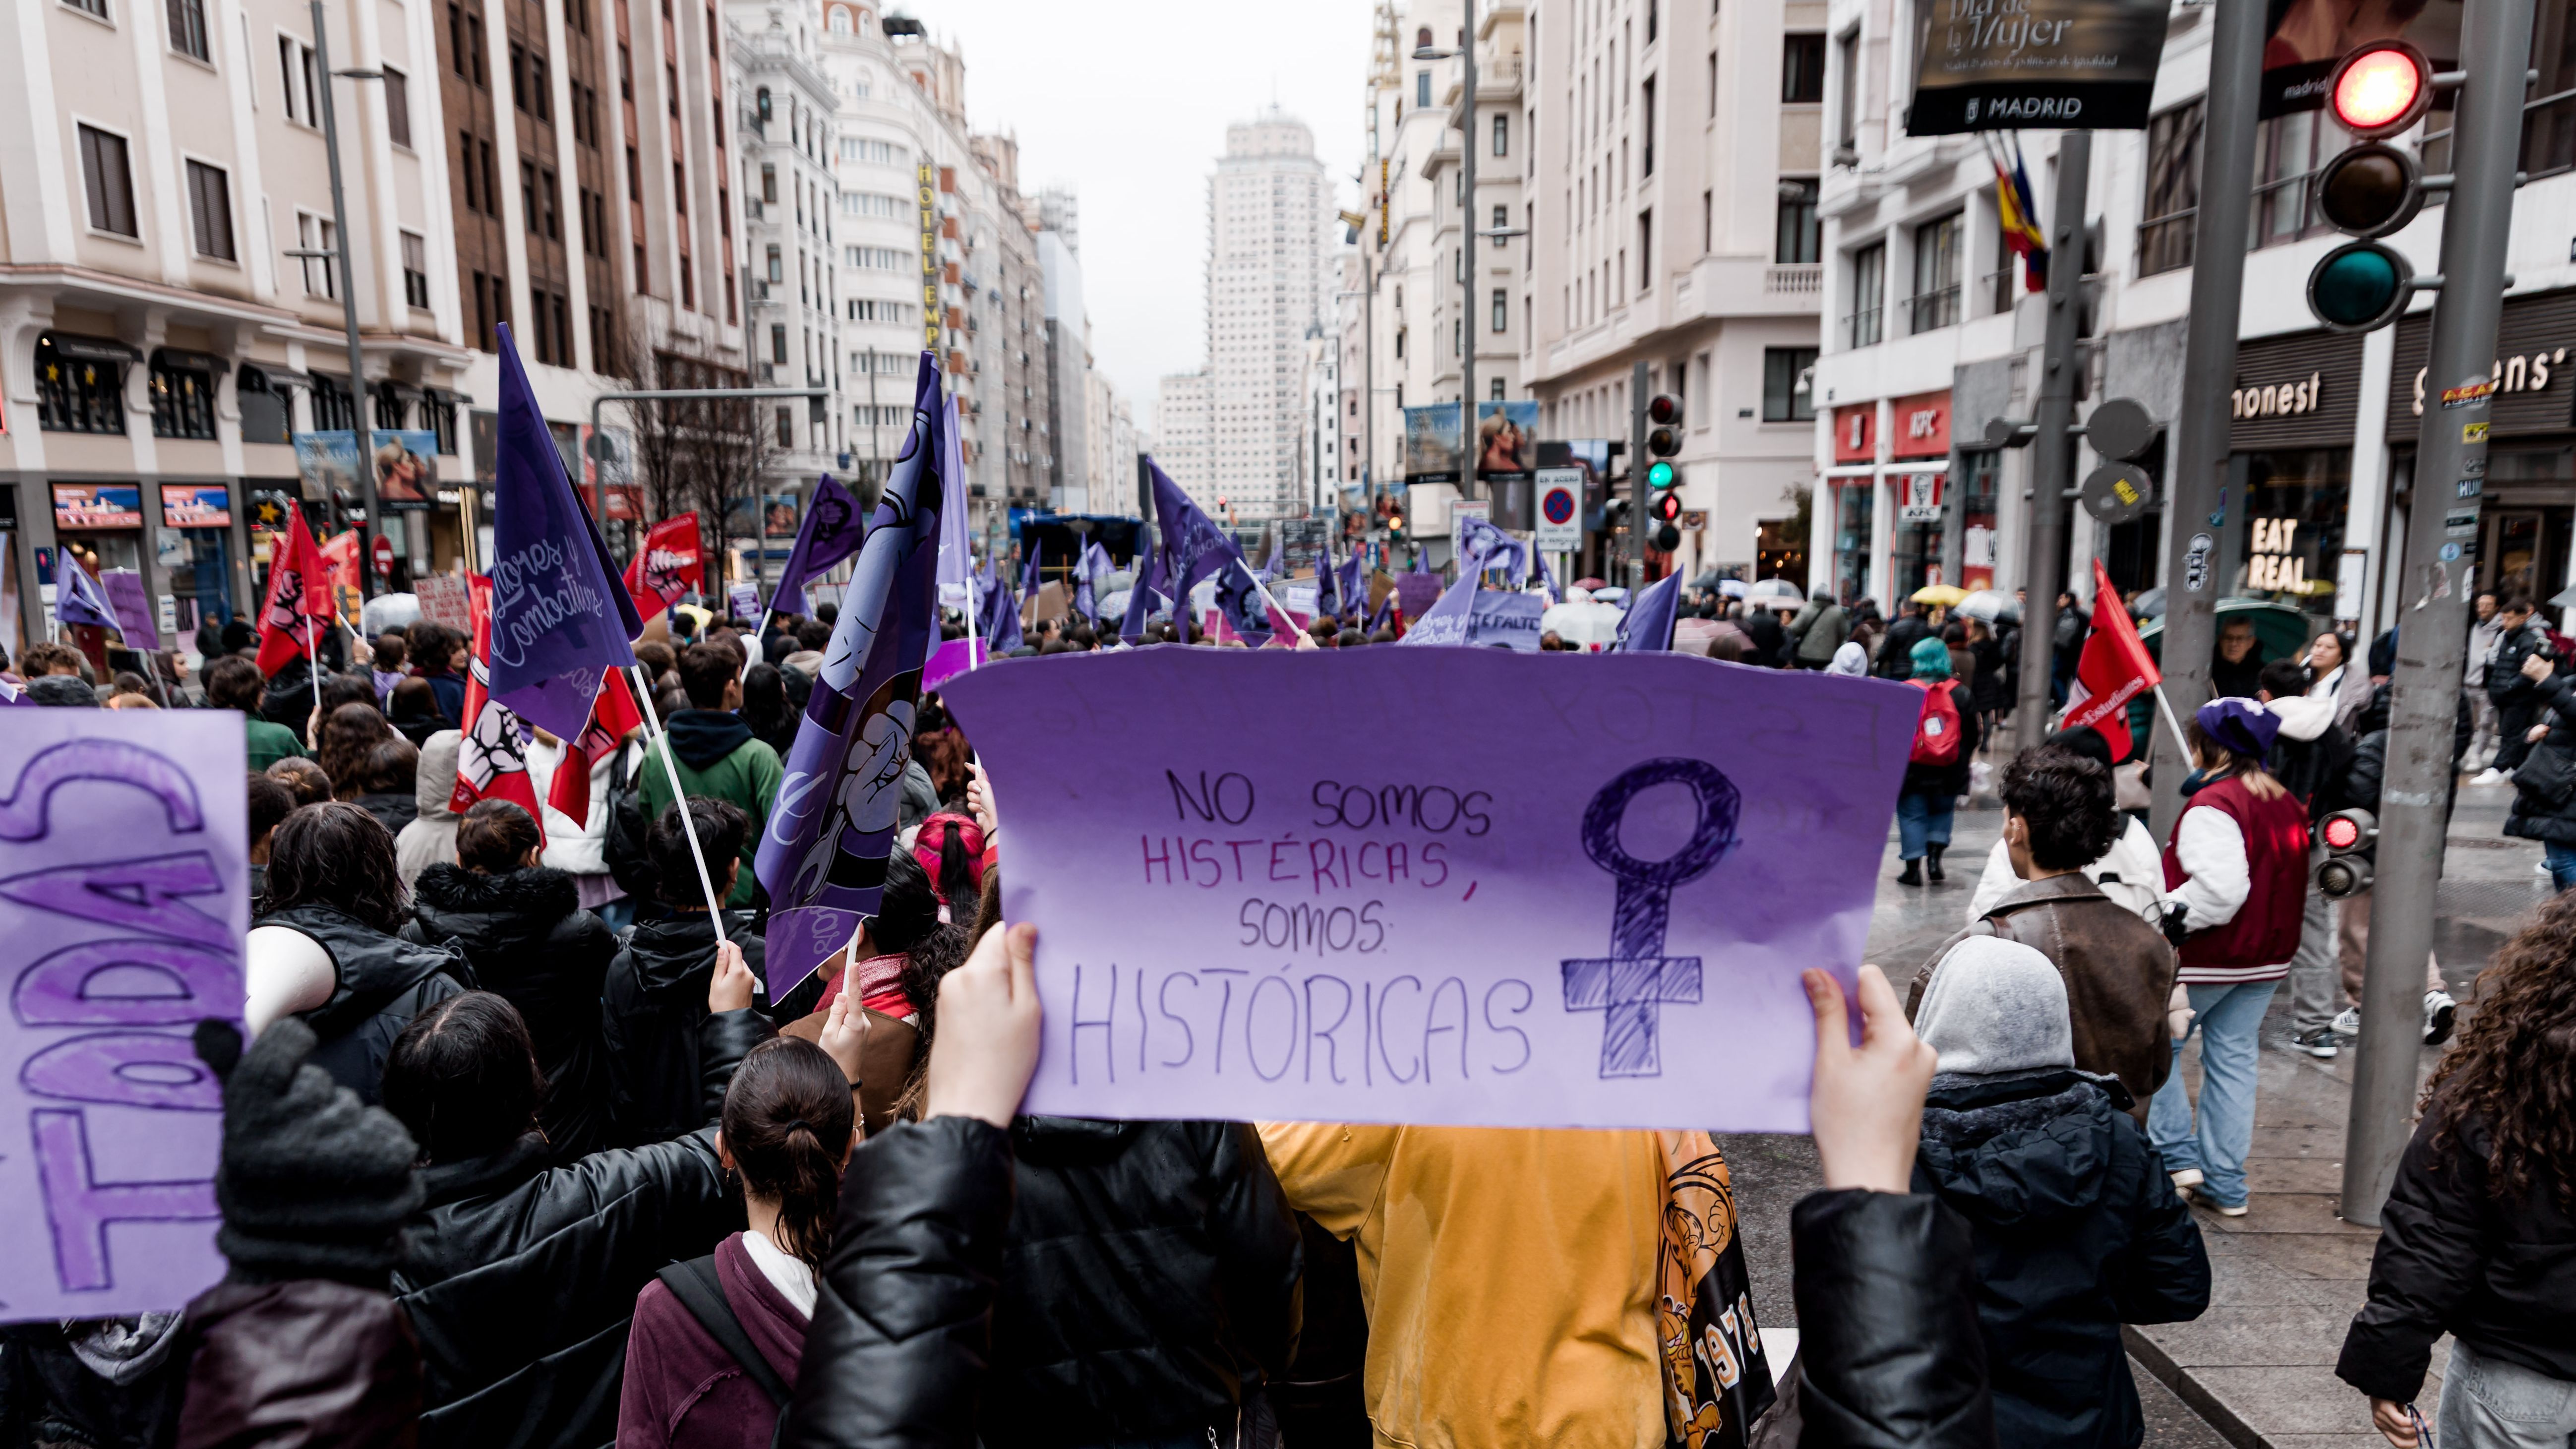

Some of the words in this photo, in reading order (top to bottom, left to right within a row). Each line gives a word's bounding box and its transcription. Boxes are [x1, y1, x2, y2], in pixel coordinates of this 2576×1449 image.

[1988, 97, 2082, 120] MADRID
[917, 163, 936, 276] HOTEL
[1909, 410, 1936, 438] KFC
[1554, 475, 1579, 483] ACERA
[1907, 507, 1935, 517] KFC
[2251, 517, 2297, 554] EAT
[2248, 554, 2314, 594] REAL.
[2082, 675, 2146, 727] Estudiantes
[1165, 769, 1255, 826] NO
[1312, 779, 1494, 837] SOMOS
[1141, 832, 1478, 902] HISTÉRICAS,
[0, 737, 244, 1295] TODAS
[1070, 963, 1533, 1087] HISTÓRICAS
[1695, 1290, 1758, 1402] 1978
